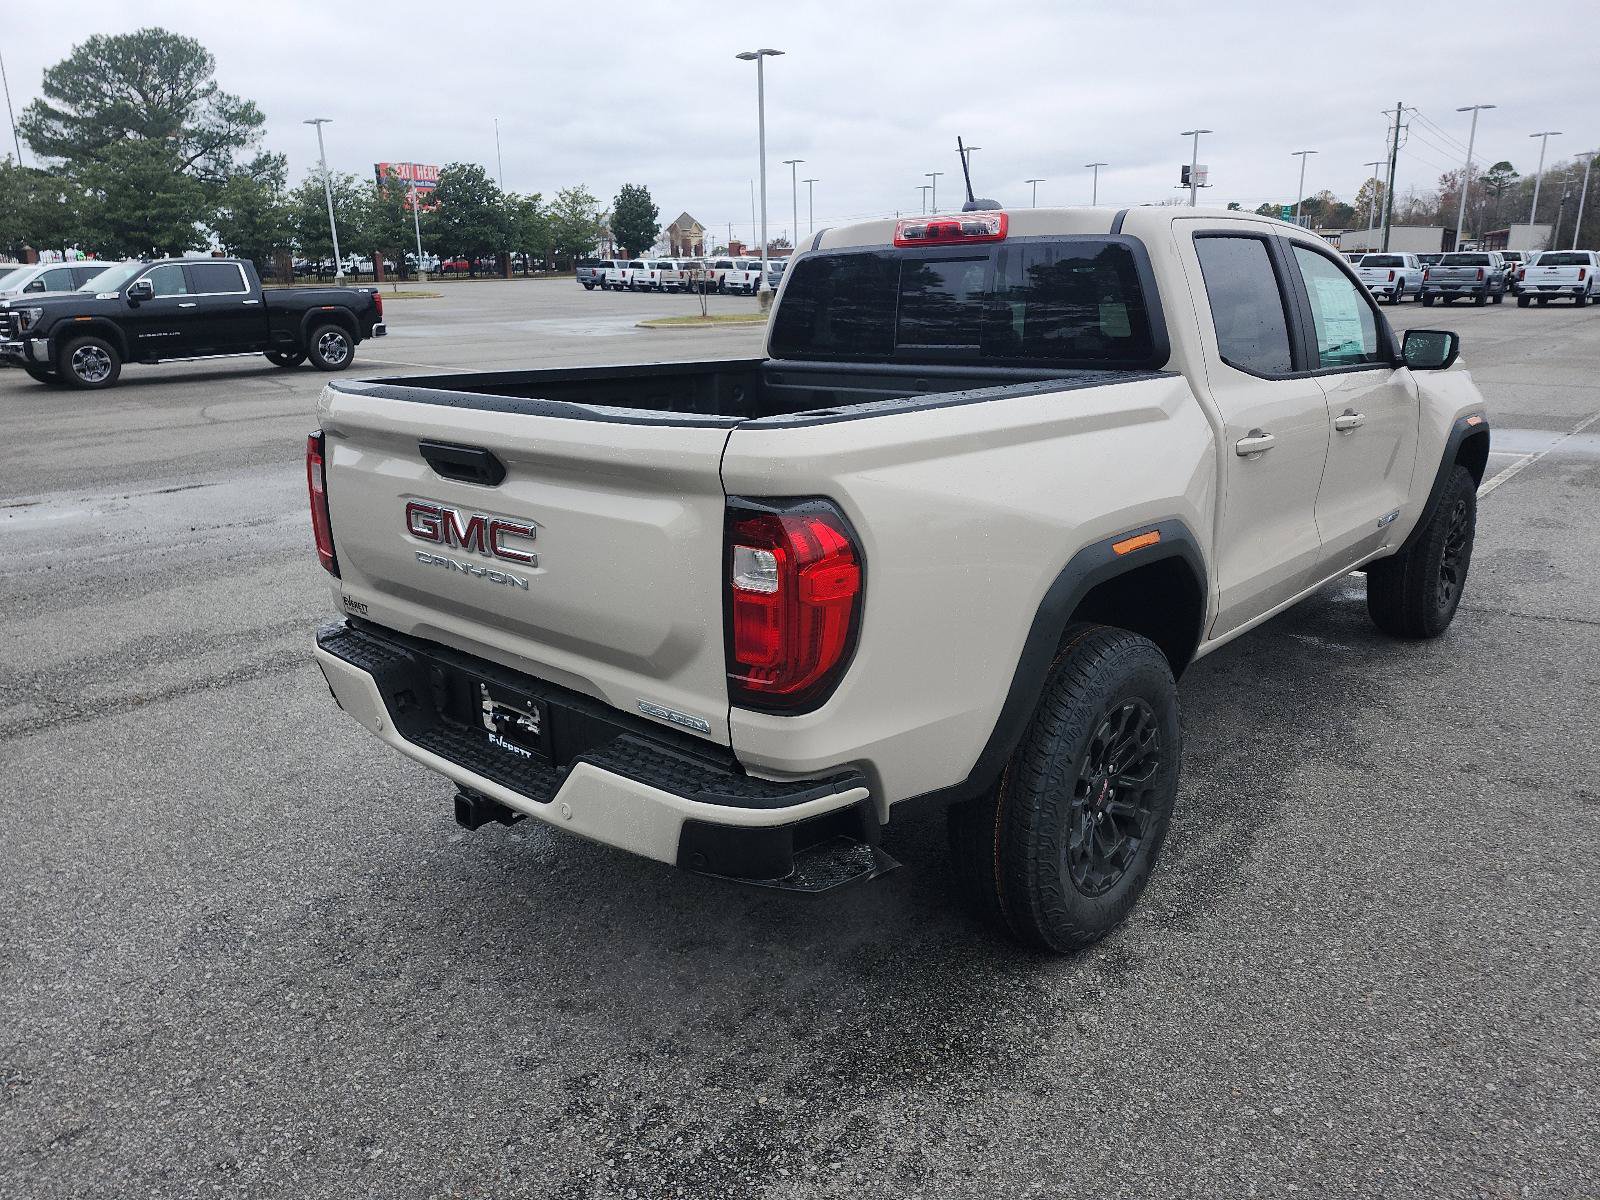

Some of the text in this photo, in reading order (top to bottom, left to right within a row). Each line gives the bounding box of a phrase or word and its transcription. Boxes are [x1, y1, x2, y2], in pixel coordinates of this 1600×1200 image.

[416, 165, 439, 180] HERE
[405, 500, 539, 568] GMC
[415, 550, 529, 591] CANYON
[488, 733, 532, 758] EVERETT
